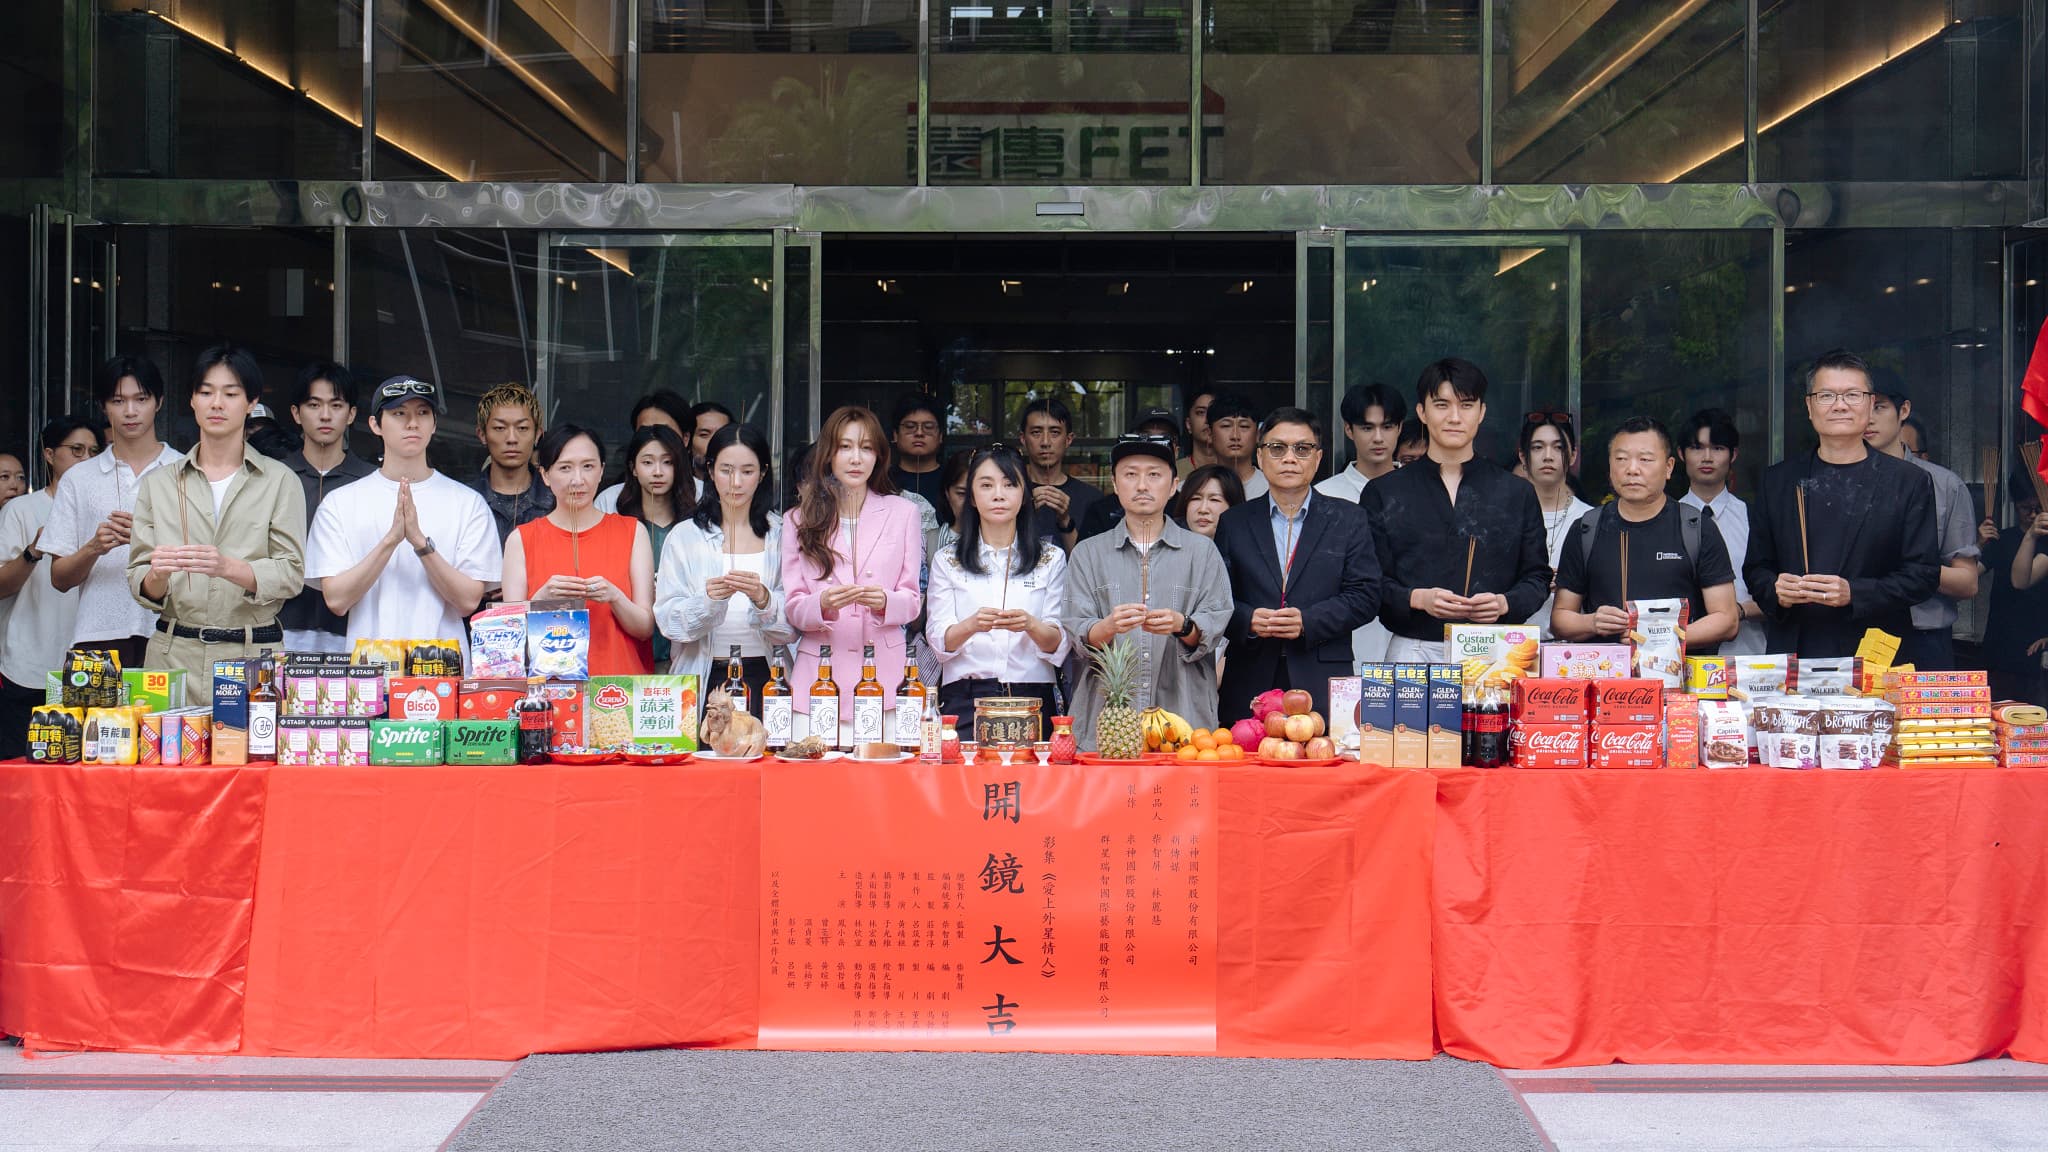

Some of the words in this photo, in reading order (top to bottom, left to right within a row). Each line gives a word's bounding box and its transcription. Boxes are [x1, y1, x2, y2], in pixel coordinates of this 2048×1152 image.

[1080, 126, 1224, 178] FET
[1457, 633, 1495, 644] Custard
[1463, 643, 1489, 653] Cake
[147, 674, 167, 687] 30
[643, 687, 671, 697] 喜年來
[1528, 687, 1580, 704] Coca-Cola
[1603, 688, 1656, 704] Coca-Cola
[407, 701, 437, 712] Bisco
[640, 698, 675, 712] 蔬菜
[640, 715, 675, 730] 薄餅
[1825, 714, 1868, 729] BROWNIE
[377, 726, 430, 748] Sprite
[455, 726, 507, 746] Sprite
[1717, 727, 1740, 735] Captiva
[1528, 731, 1582, 749] Coca-Cola
[1601, 732, 1655, 750] Coca-Cola
[1152, 783, 1164, 821] 出品人
[1190, 783, 1200, 808] 出品
[1043, 835, 1056, 865] 影集
[977, 780, 1026, 1037] 開鏡大吉
[1041, 872, 1057, 978] 《愛上外星情人》
